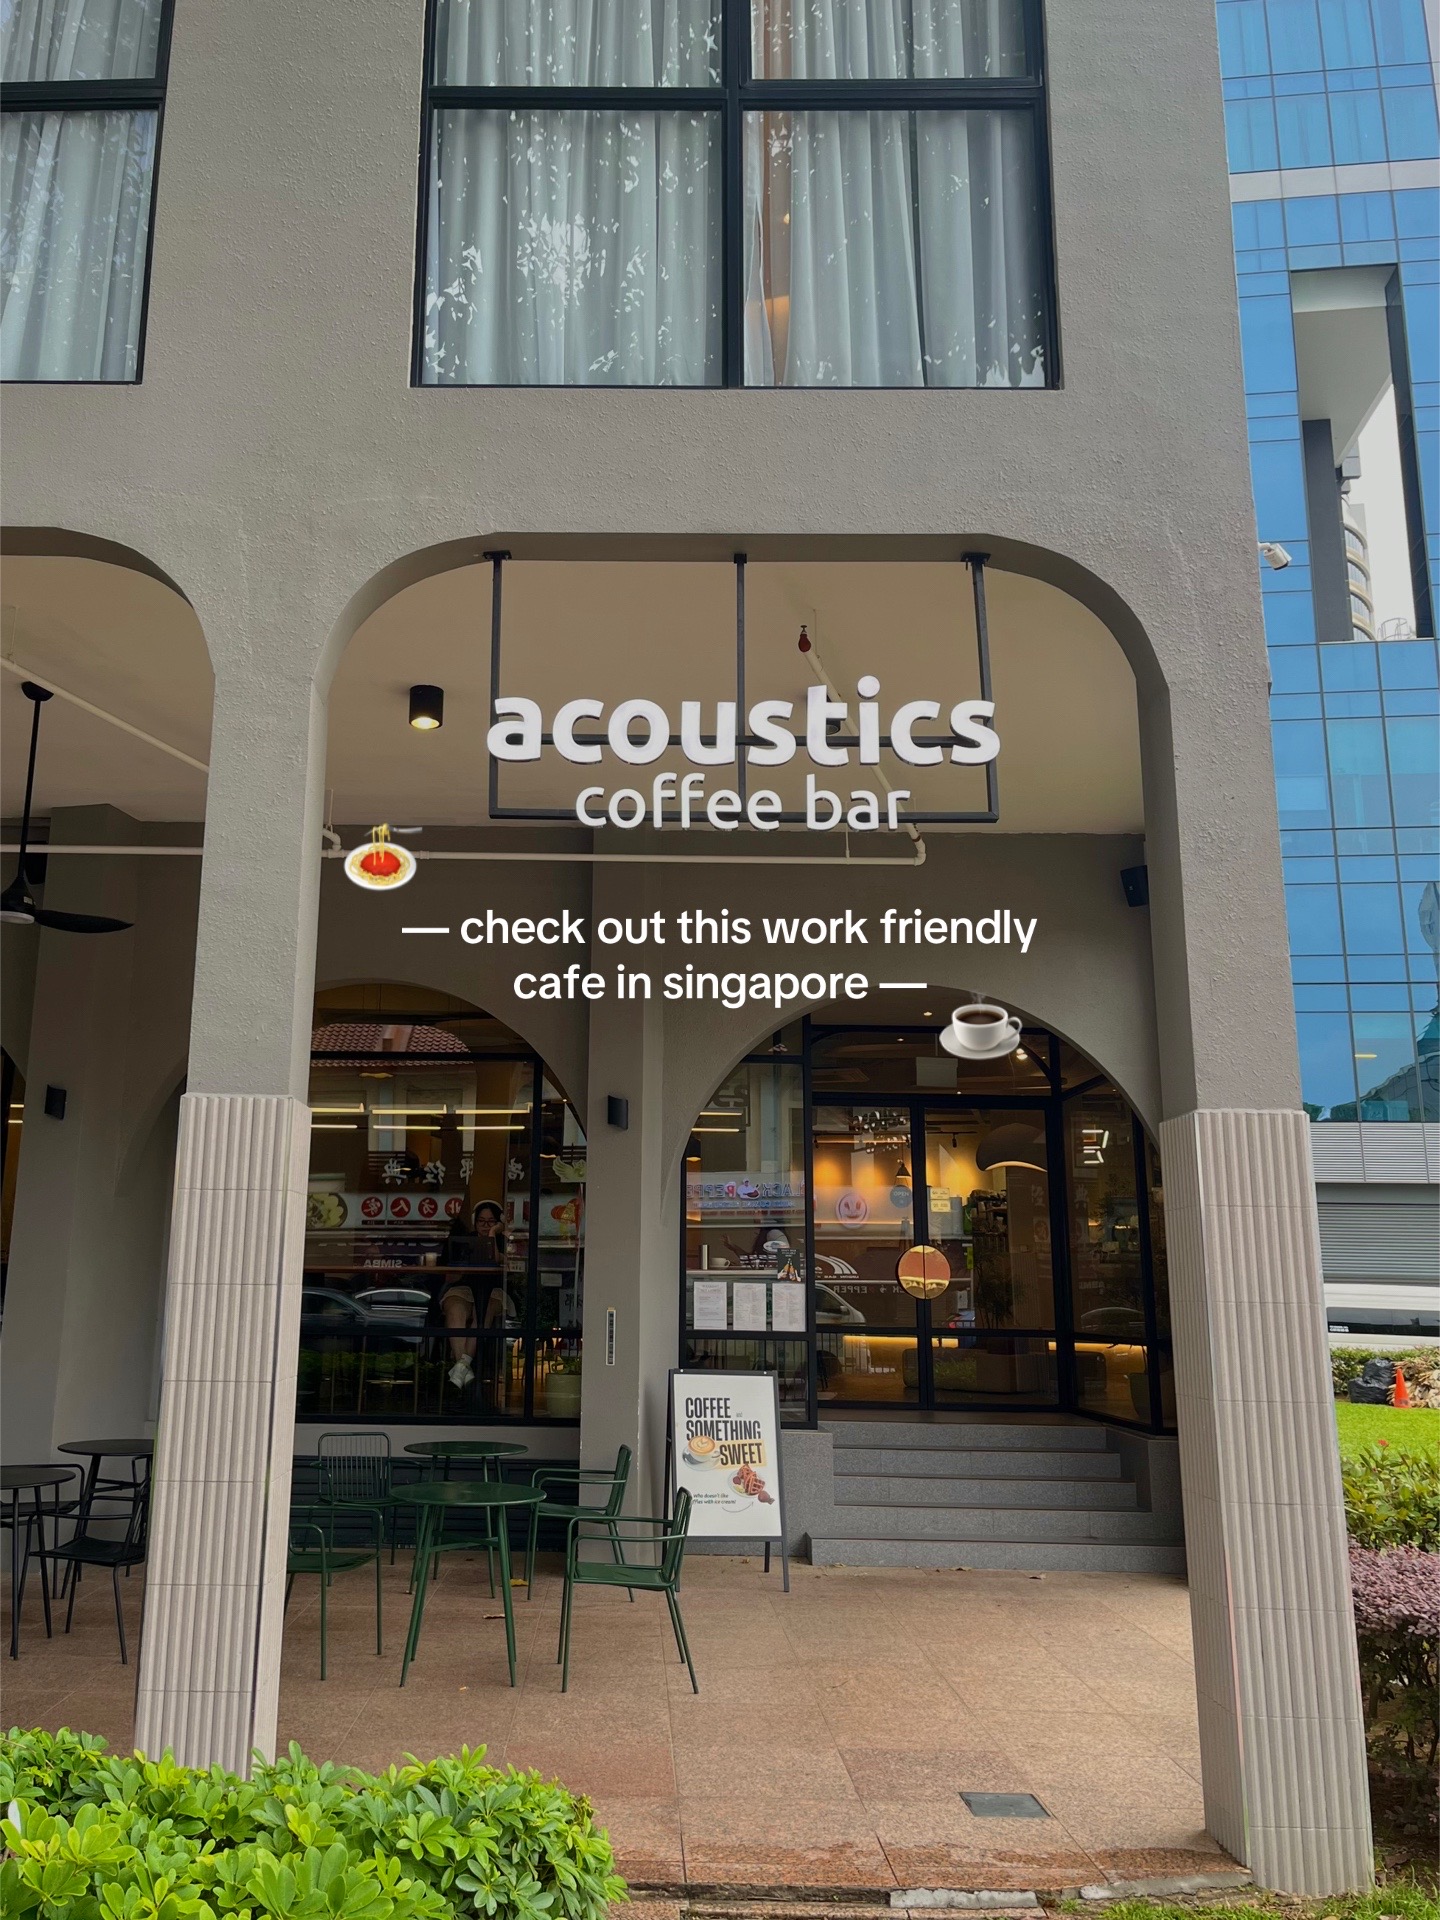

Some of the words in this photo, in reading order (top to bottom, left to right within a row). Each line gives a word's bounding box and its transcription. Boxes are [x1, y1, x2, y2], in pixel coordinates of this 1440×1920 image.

[487, 675, 1002, 766] acoustics
[575, 772, 783, 830] coffee
[806, 773, 912, 831] bar
[685, 1397, 731, 1418] COFFEE
[686, 1420, 761, 1441] SOMETHING
[719, 1443, 762, 1466] SWEET
